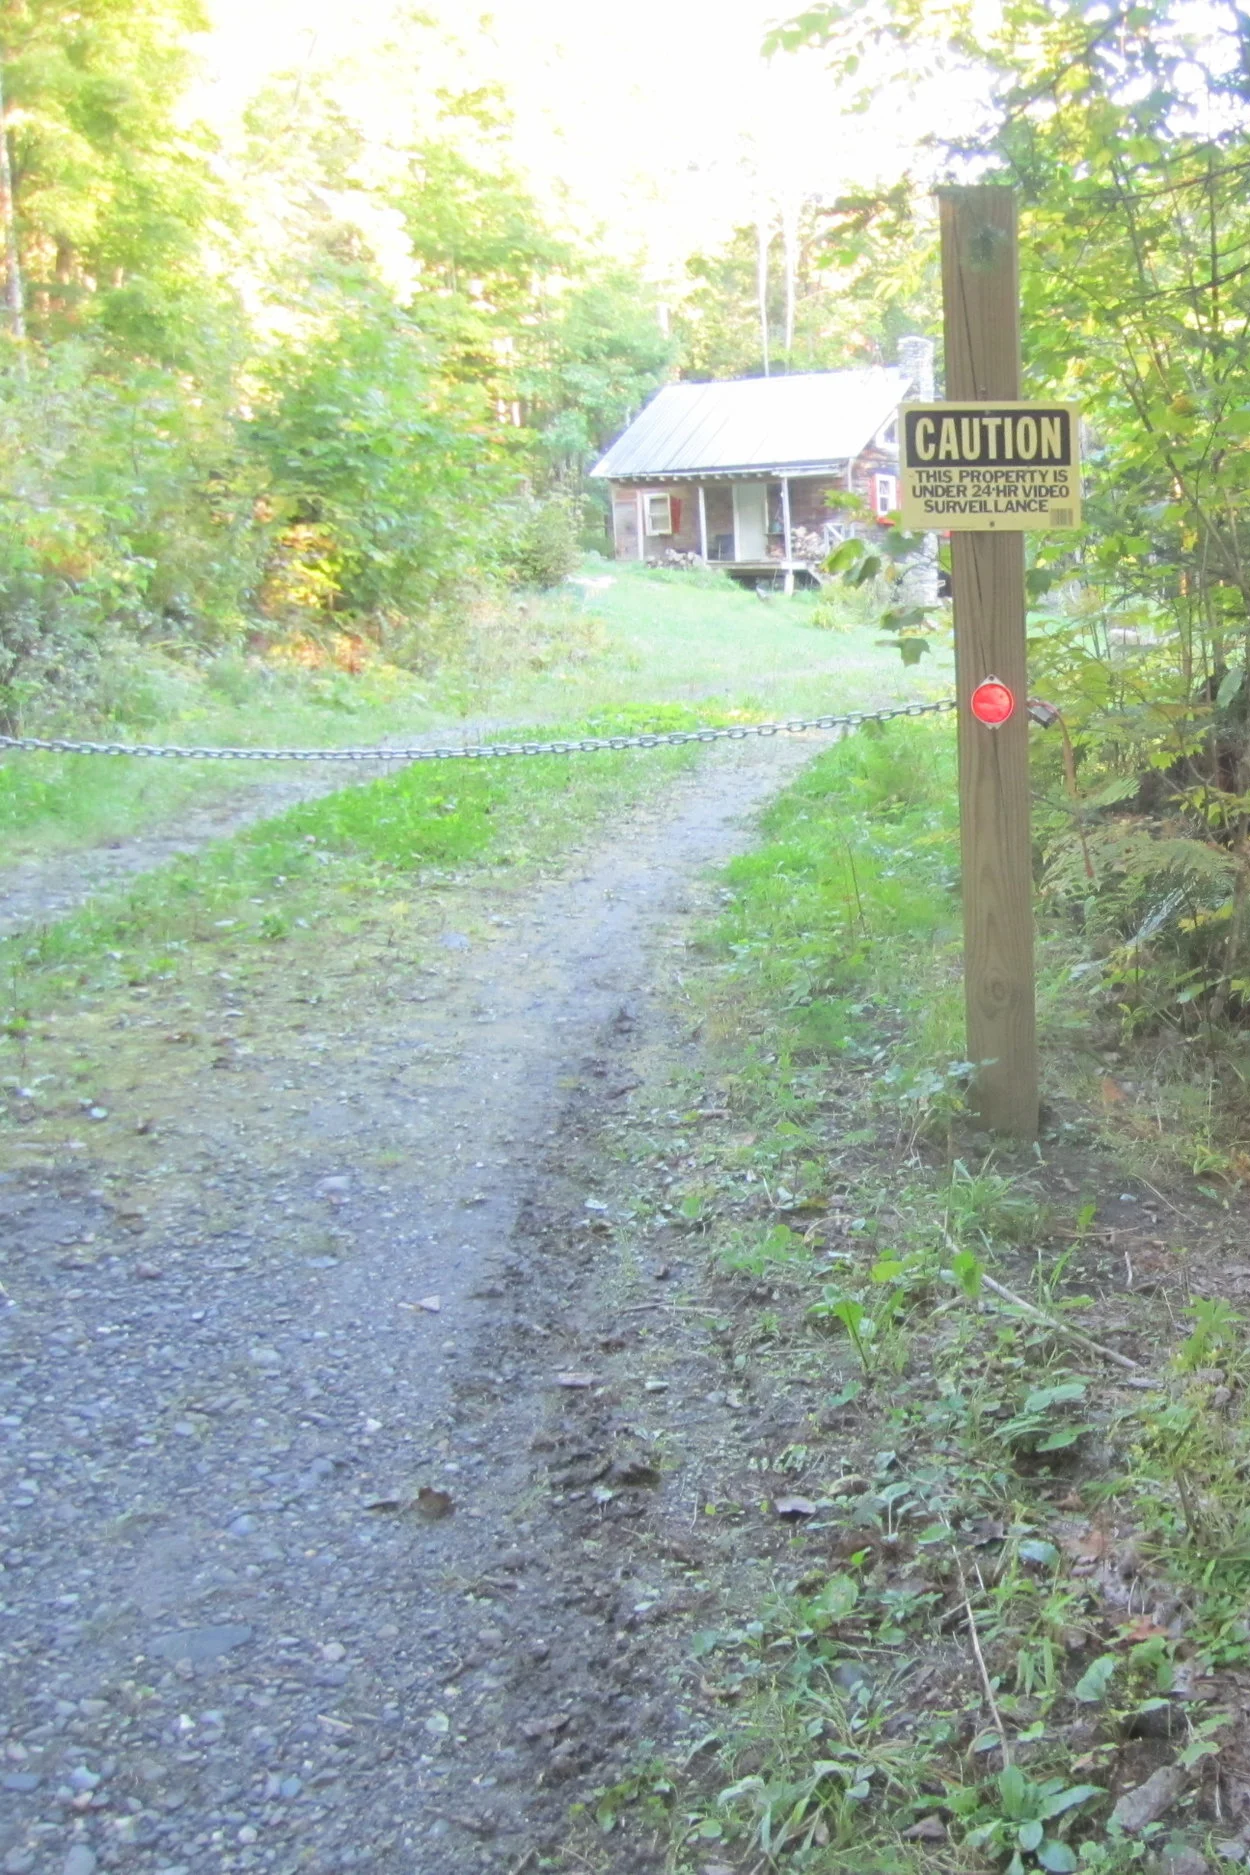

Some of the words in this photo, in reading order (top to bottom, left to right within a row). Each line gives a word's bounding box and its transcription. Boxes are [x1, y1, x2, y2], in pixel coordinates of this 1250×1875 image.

[915, 416, 1062, 460] CAUTION
[915, 470, 953, 484] THIS
[959, 470, 1049, 484] PROPERTY
[1053, 469, 1069, 482] IS
[912, 485, 968, 499] UNDER
[1022, 484, 1070, 498] VIDEO
[924, 500, 1049, 514] SURVEILLANCE
